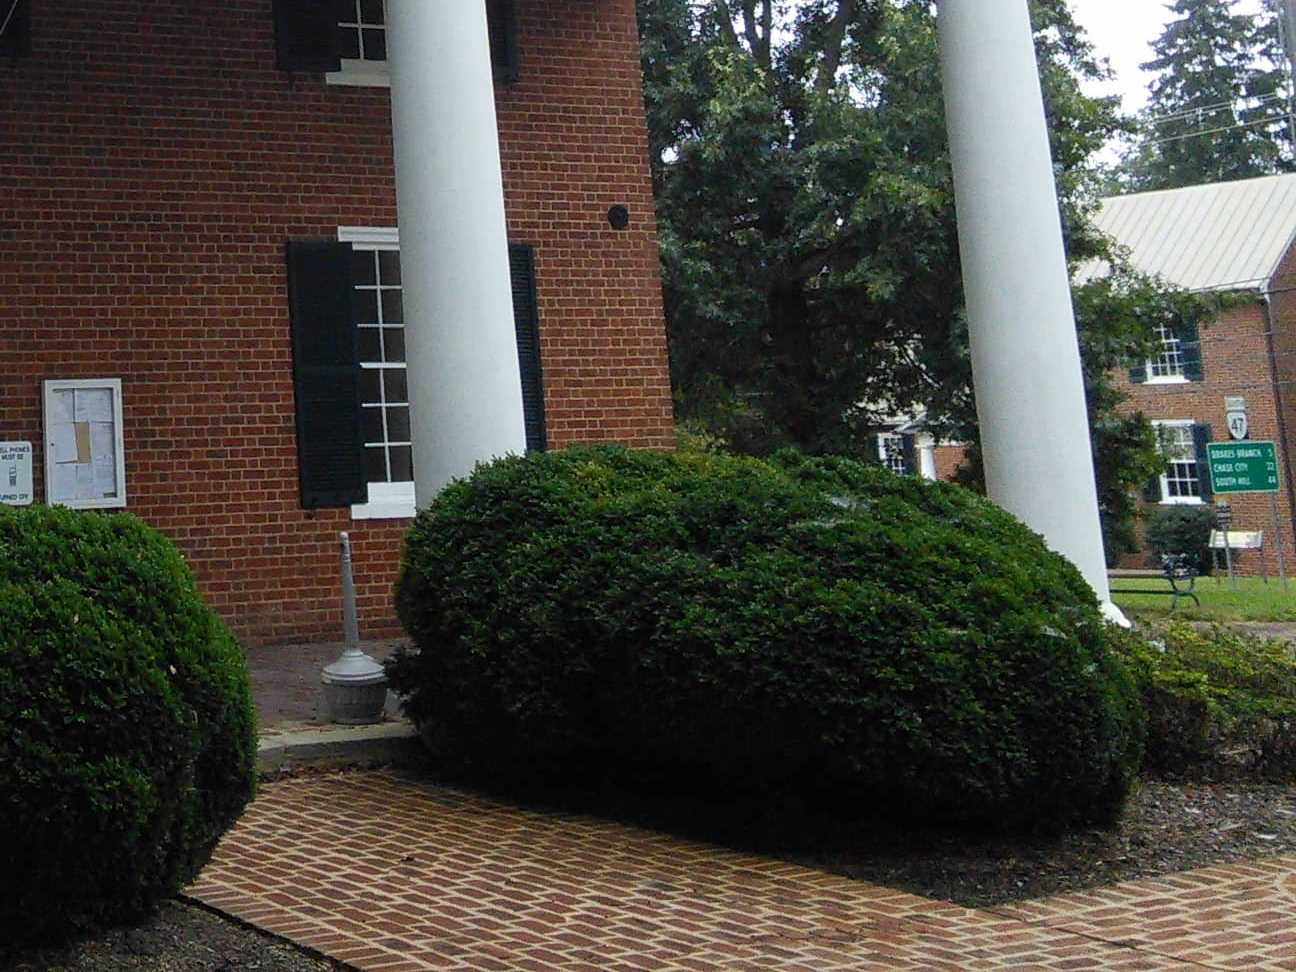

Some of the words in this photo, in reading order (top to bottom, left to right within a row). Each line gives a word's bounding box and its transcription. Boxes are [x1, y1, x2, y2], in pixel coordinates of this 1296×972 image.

[1231, 417, 1244, 432] 47
[1237, 449, 1262, 458] BRANCH
[1213, 463, 1233, 472] CHASE
[1234, 463, 1248, 472] CITY
[1215, 477, 1236, 486] SOUTH
[1238, 477, 1251, 485] HILL
